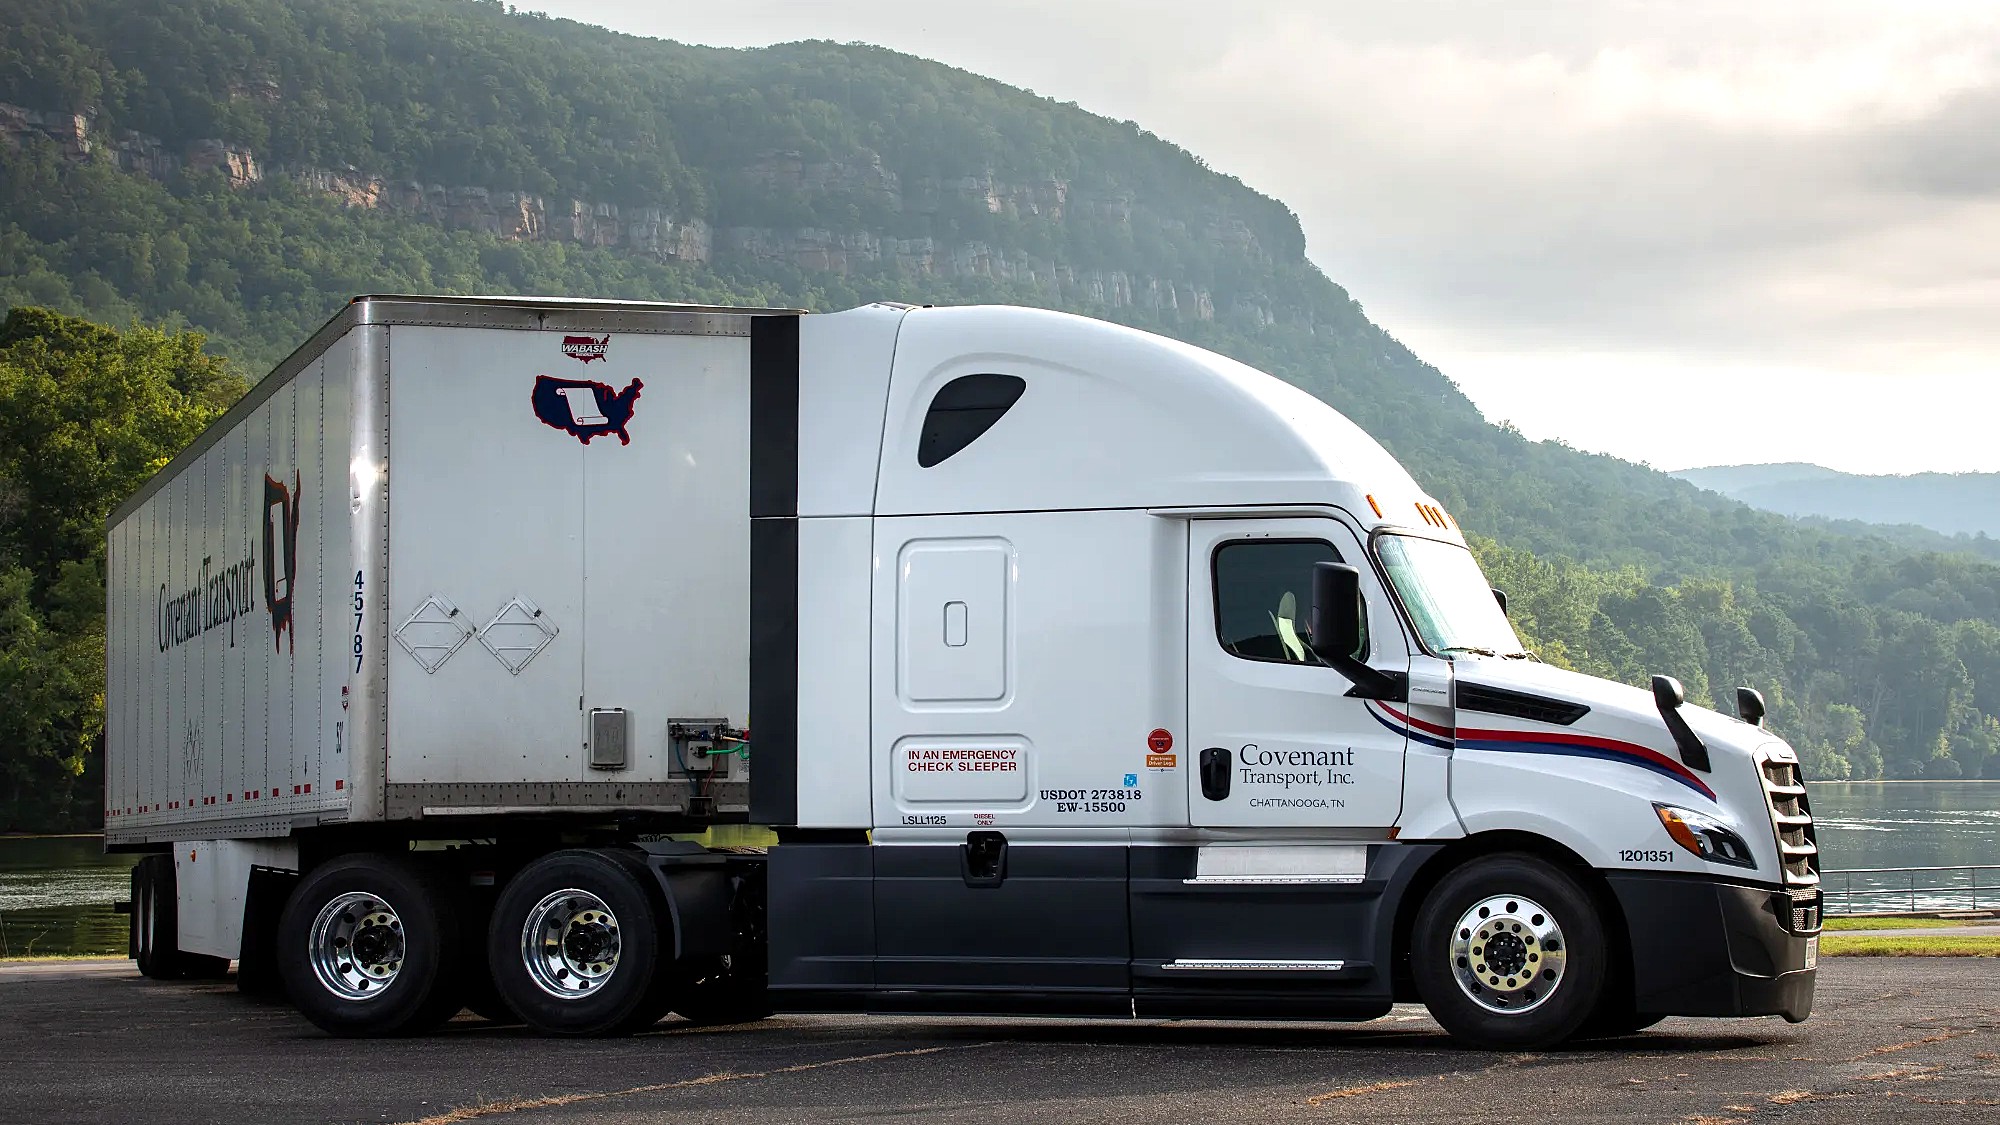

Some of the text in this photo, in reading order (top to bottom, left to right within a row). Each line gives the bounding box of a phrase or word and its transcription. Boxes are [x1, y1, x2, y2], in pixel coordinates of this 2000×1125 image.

[562, 344, 608, 353] WABASH
[159, 536, 255, 653] Covenant Transport
[354, 570, 364, 674] 45787
[908, 750, 1016, 760] IN AN EMERGENCY
[1240, 743, 1354, 766] Covenant
[908, 762, 1017, 771] CHECK SLEEPER
[1240, 768, 1354, 789] Transport, Inc.
[1040, 790, 1142, 800] USDOT 273818
[1057, 802, 1126, 812] EW-15500
[1249, 798, 1345, 808] CHATTANOOGA, TN
[902, 815, 947, 825] LSLL1125
[1619, 850, 1673, 862] 1201351
